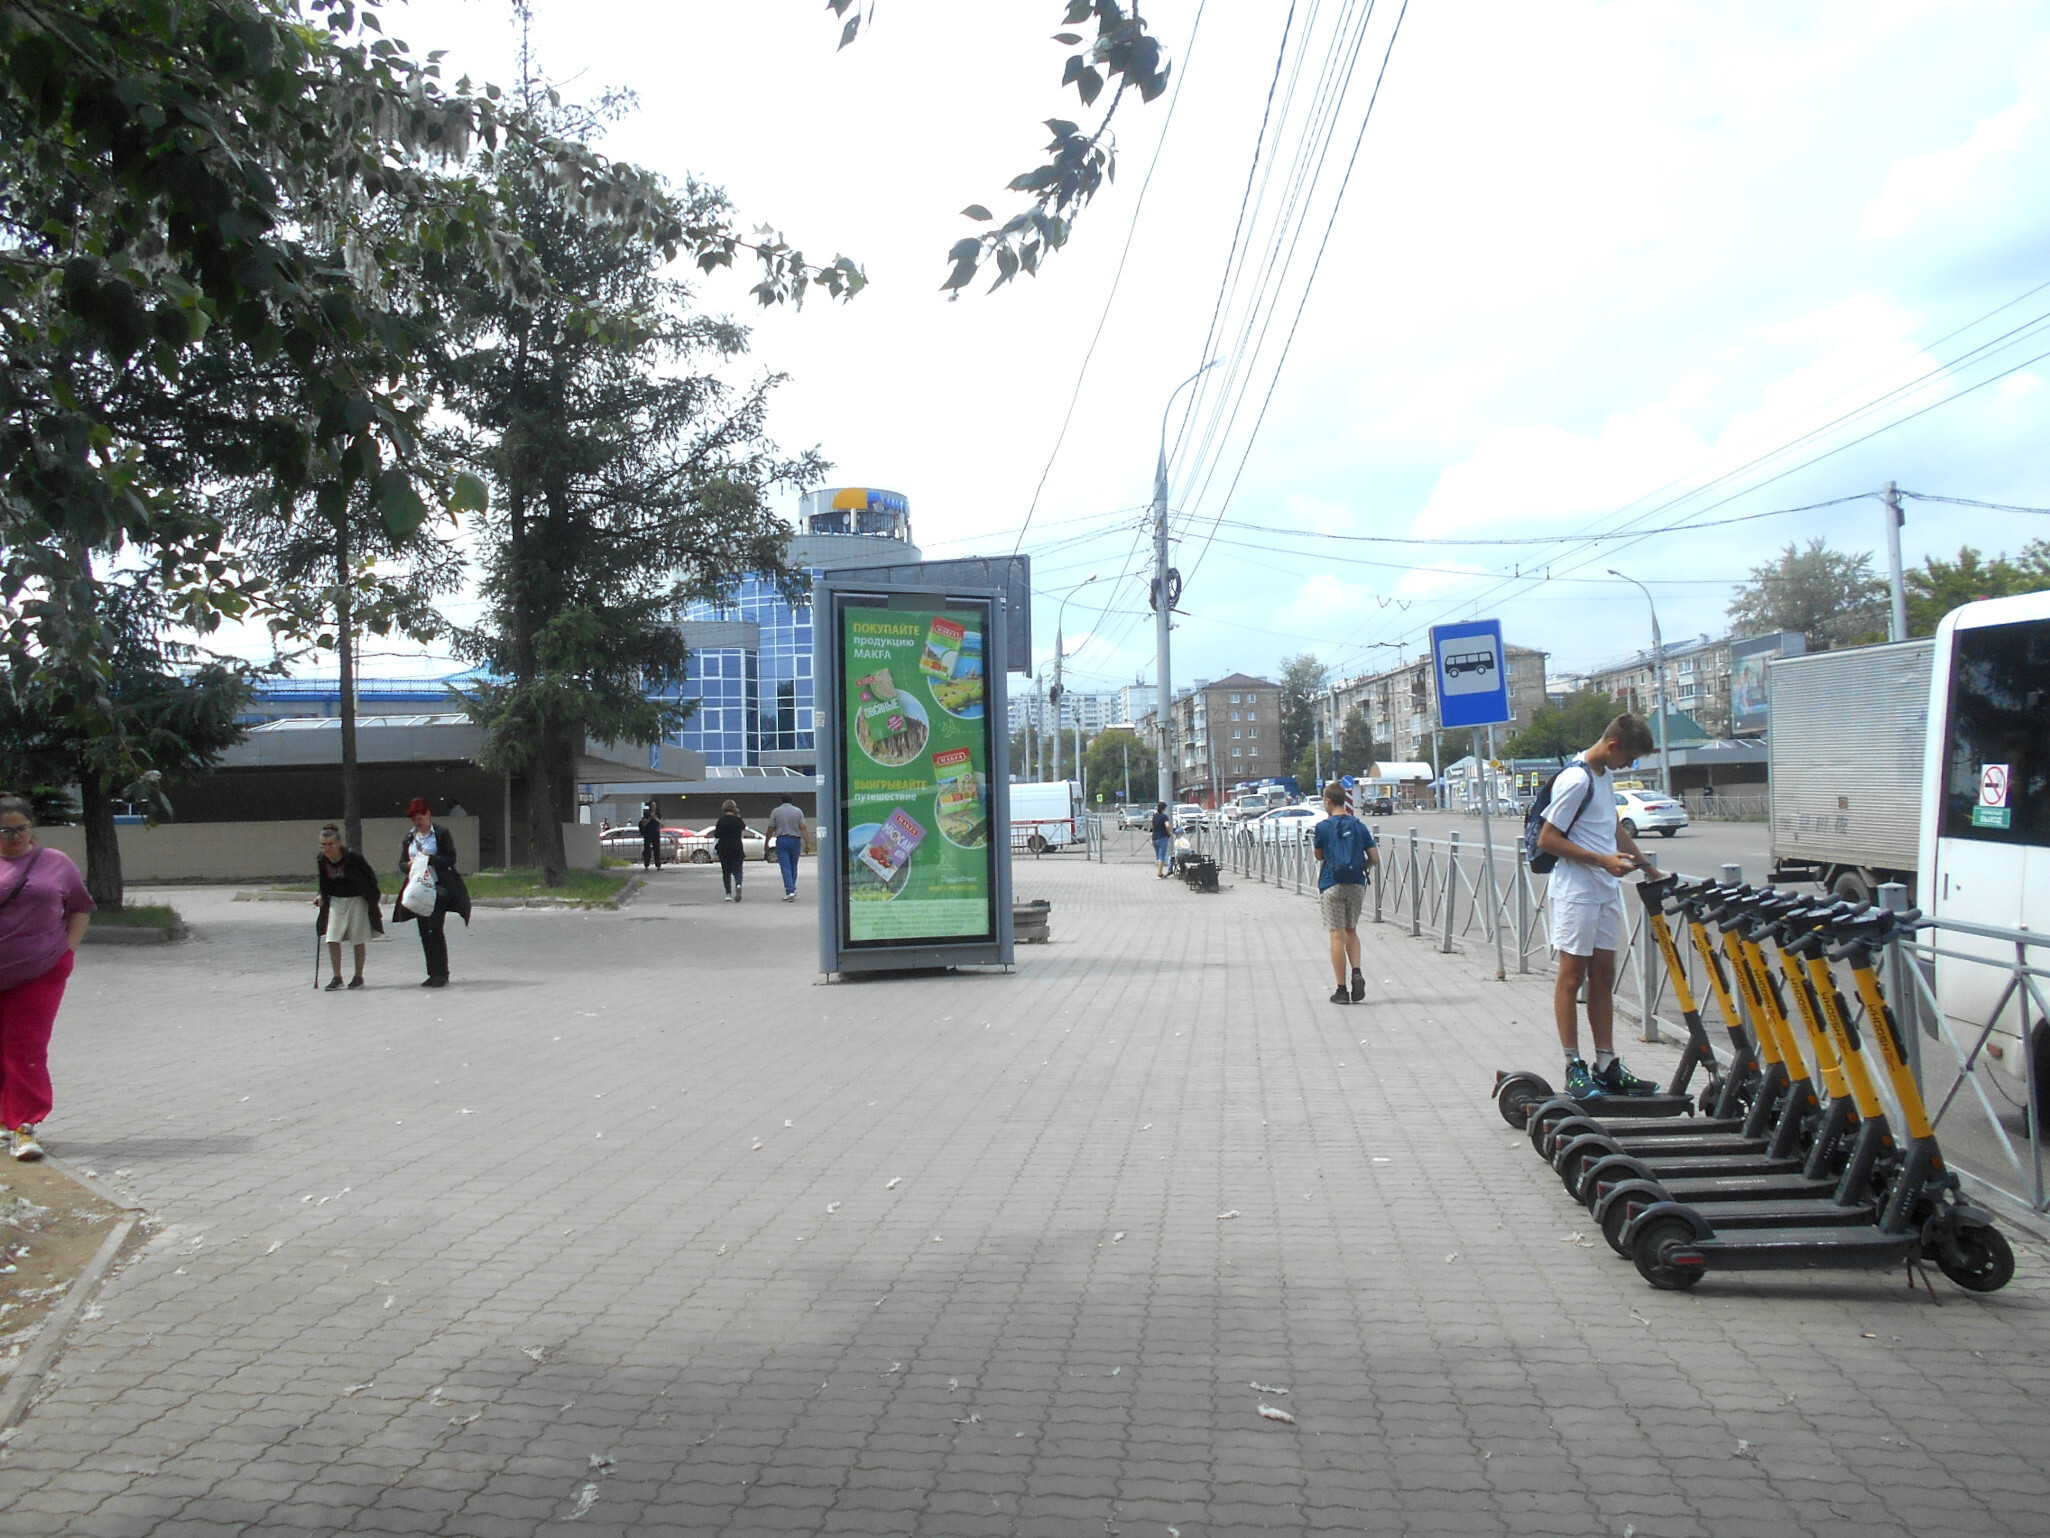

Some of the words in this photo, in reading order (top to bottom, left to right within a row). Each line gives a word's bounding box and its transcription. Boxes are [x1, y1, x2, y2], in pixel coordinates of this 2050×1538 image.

[853, 622, 920, 636] ПОКУПАЙТЕ
[854, 637, 915, 647] продукцию
[854, 649, 892, 660] MAKFA
[854, 779, 927, 790] ВЫИГРЫВАЙТЕ
[854, 793, 917, 803] путешествие
[1790, 978, 1810, 1019] WHOOSH
[1821, 991, 1842, 1036] WHOOSH
[1867, 1003, 1891, 1052] WHOOSH
